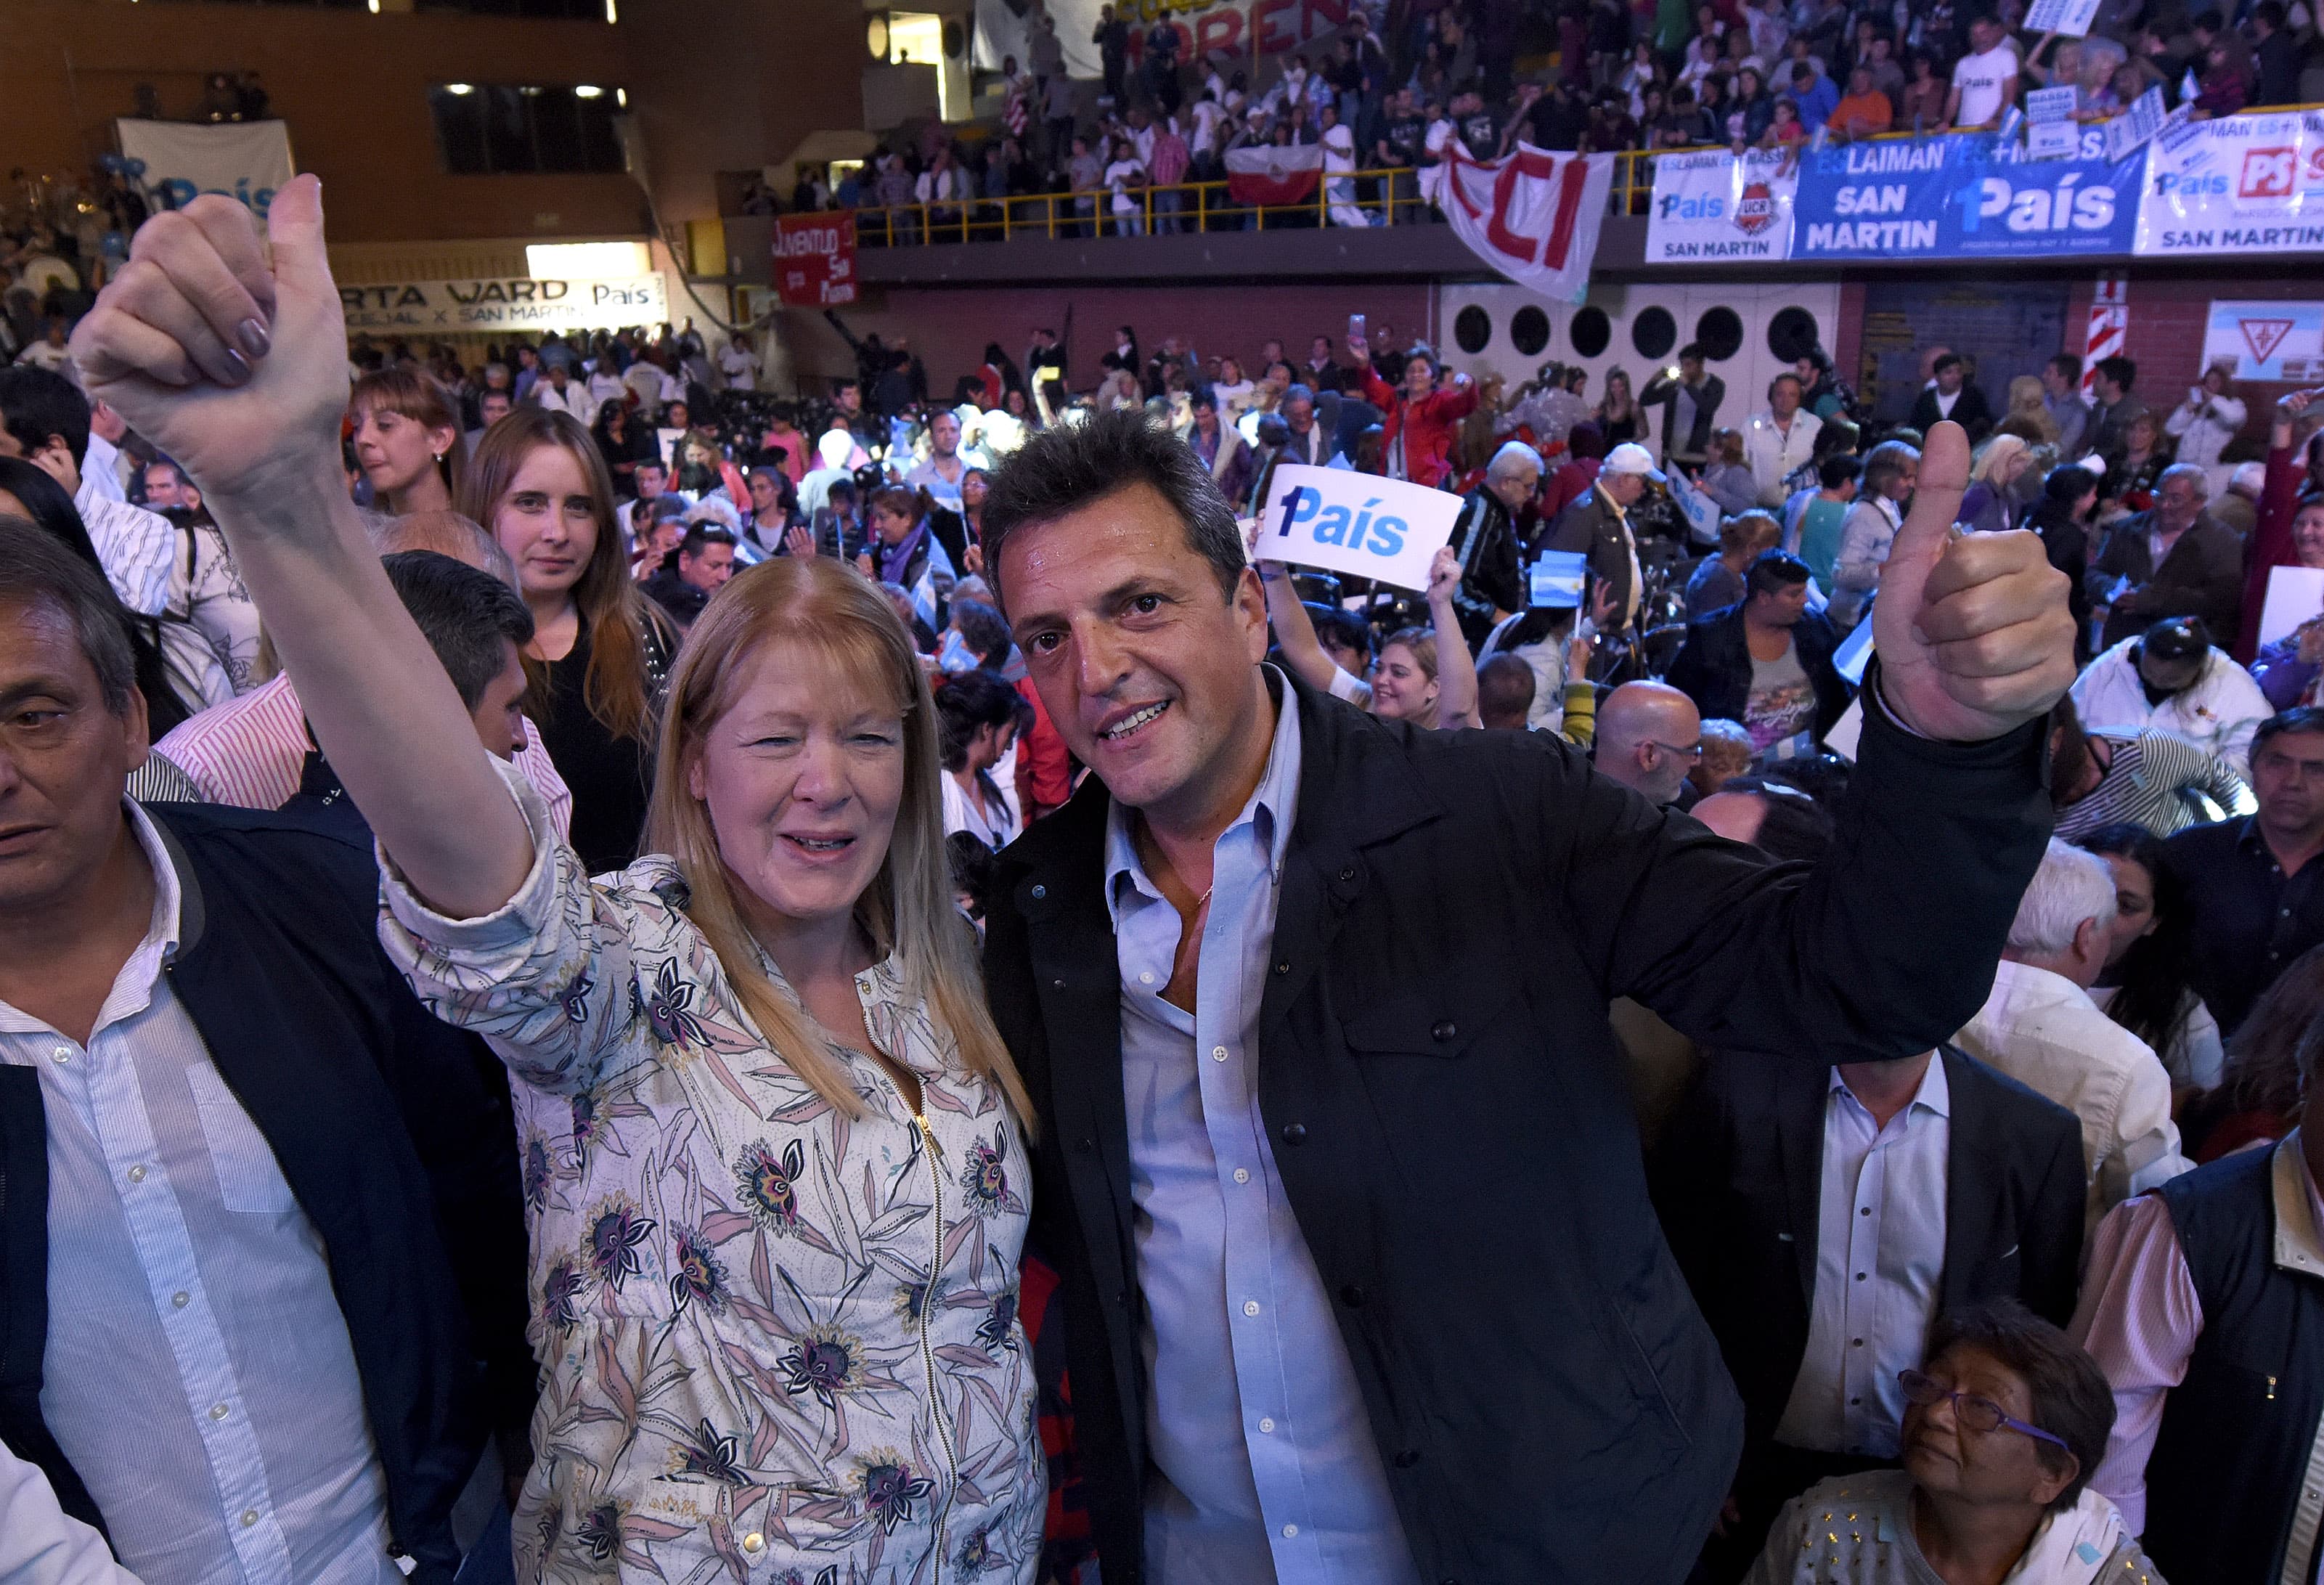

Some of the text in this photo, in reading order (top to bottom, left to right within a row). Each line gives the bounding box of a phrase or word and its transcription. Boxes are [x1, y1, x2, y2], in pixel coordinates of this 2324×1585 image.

[2244, 150, 2294, 192] PS
[1744, 200, 1766, 214] UCR
[1834, 184, 1908, 216] SAN
[1806, 219, 1938, 250] MARTIN
[2162, 227, 2324, 248] SAN MARTIN
[1665, 240, 1770, 256] SAN MARTIN
[447, 279, 568, 306] WARD
[592, 282, 650, 306] País
[459, 306, 504, 324] SAN
